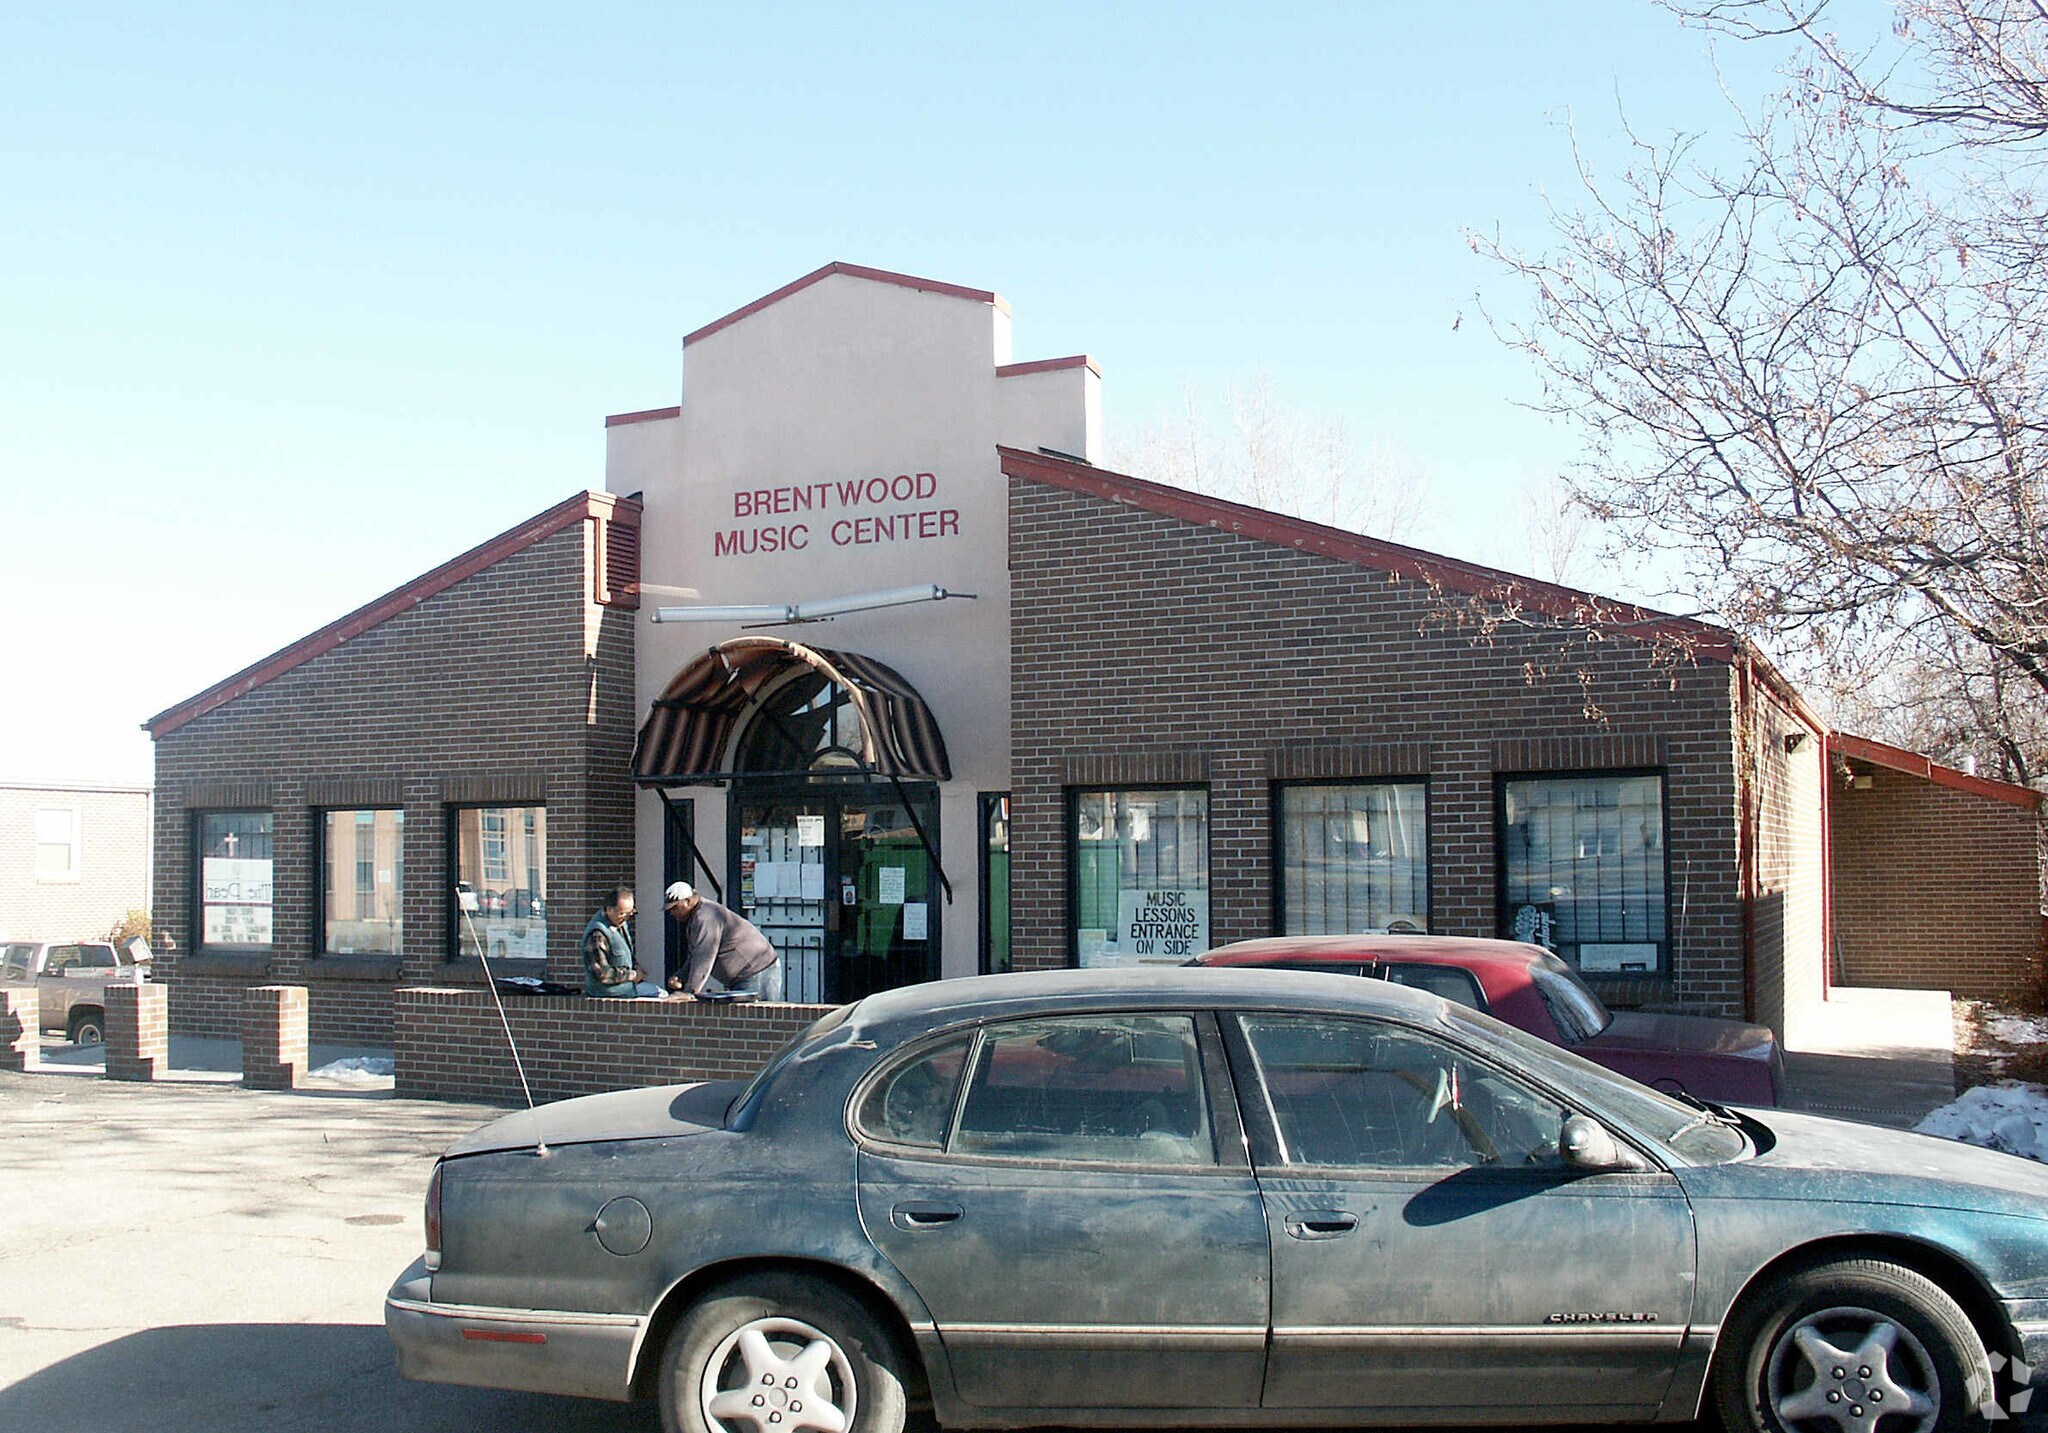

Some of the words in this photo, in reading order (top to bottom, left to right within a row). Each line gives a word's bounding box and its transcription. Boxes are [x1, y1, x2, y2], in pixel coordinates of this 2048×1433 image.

[734, 472, 937, 518] BRENTWOOD
[714, 524, 809, 557] MUSIC
[831, 509, 960, 546] CENTER
[1146, 891, 1187, 907] MUSIC
[1135, 908, 1196, 923] LESSONS
[1130, 923, 1200, 940] ENTRANCE
[1136, 940, 1154, 954] ON
[1163, 940, 1192, 955] SIDE
[1550, 1312, 1660, 1323] CHRYSLER
